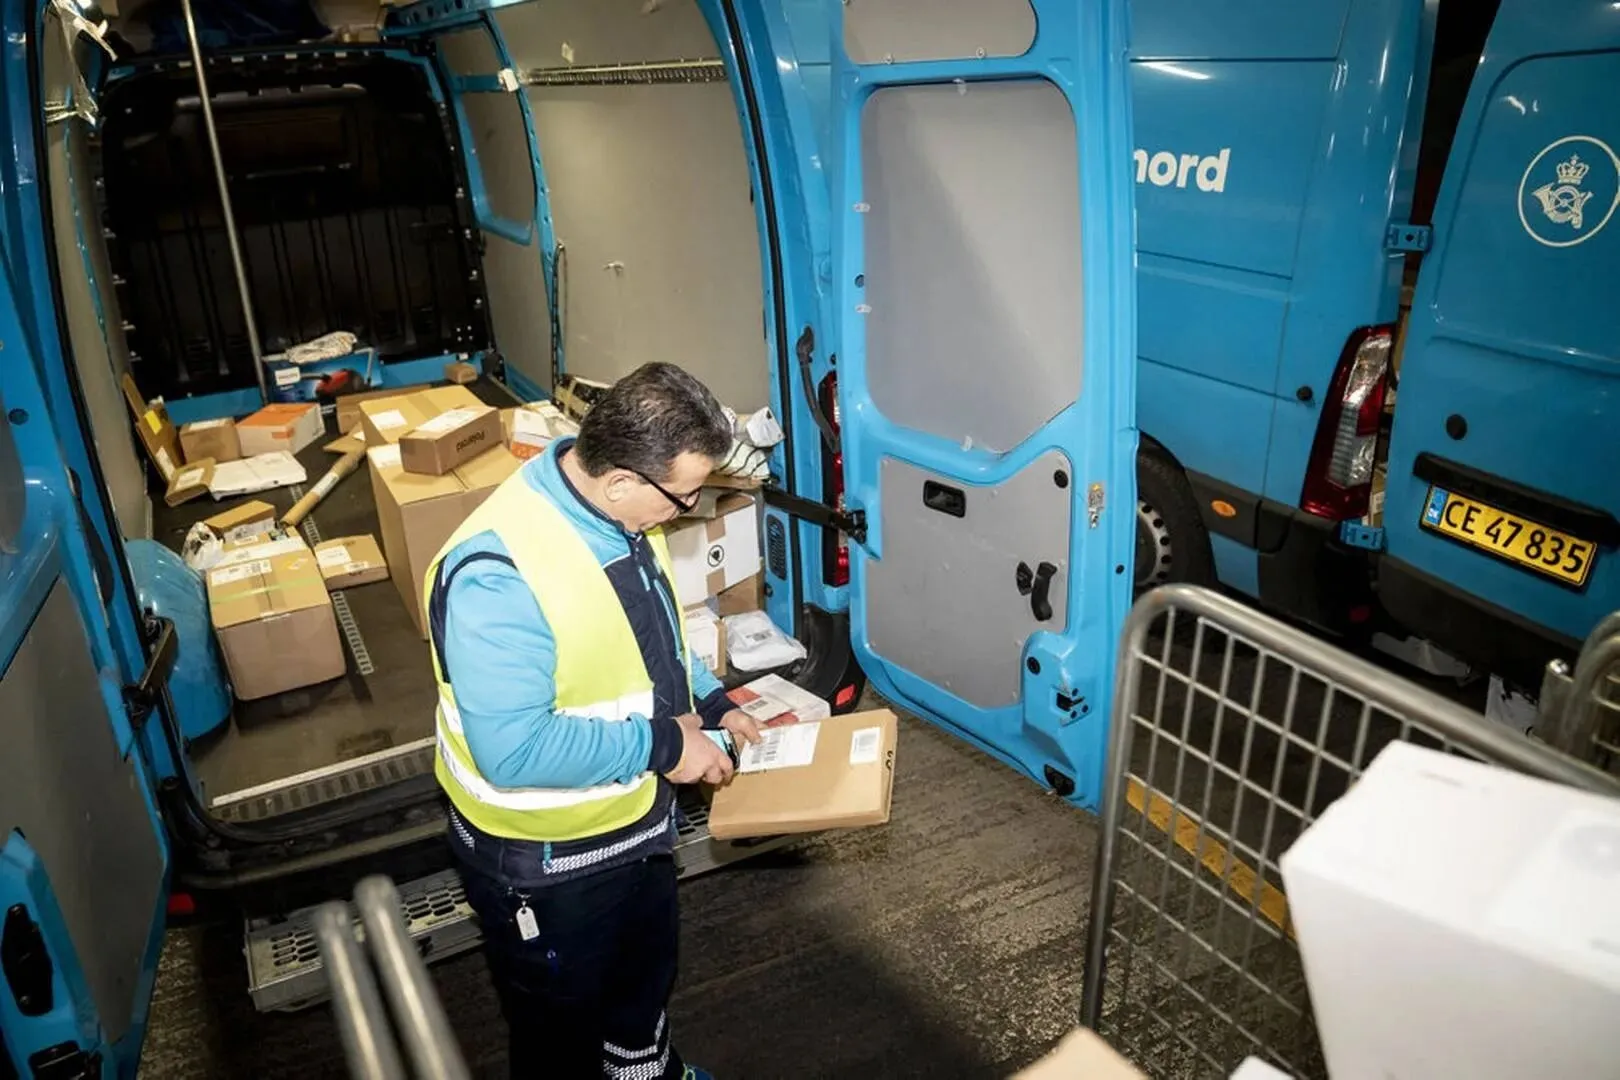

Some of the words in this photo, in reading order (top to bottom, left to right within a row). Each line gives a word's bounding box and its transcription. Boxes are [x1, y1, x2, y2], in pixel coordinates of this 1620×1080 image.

[1445, 500, 1482, 535] CE
[1485, 516, 1524, 548] 47
[1524, 529, 1587, 574] 835
